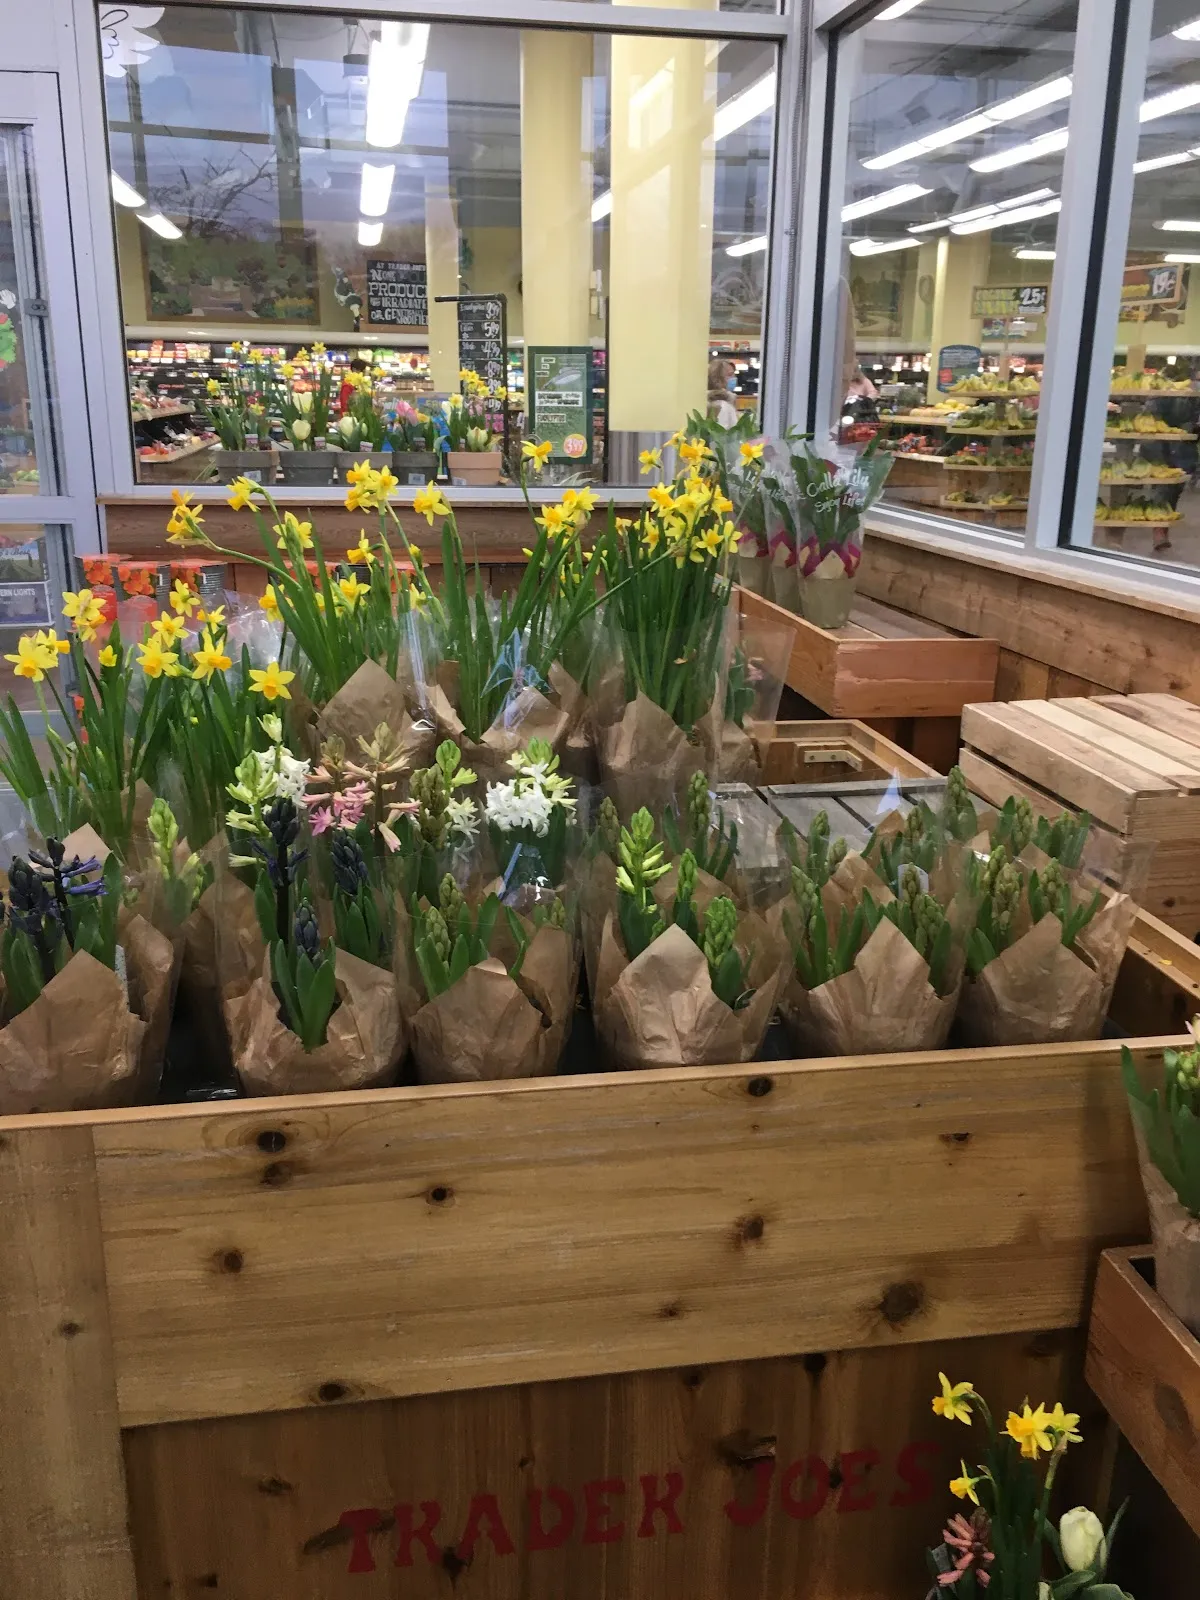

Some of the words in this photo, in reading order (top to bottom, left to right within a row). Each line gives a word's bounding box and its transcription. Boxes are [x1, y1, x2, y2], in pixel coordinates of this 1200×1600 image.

[806, 471, 841, 498] Calla
[338, 1471, 684, 1574] TRADER
[723, 1441, 943, 1527] JOES
